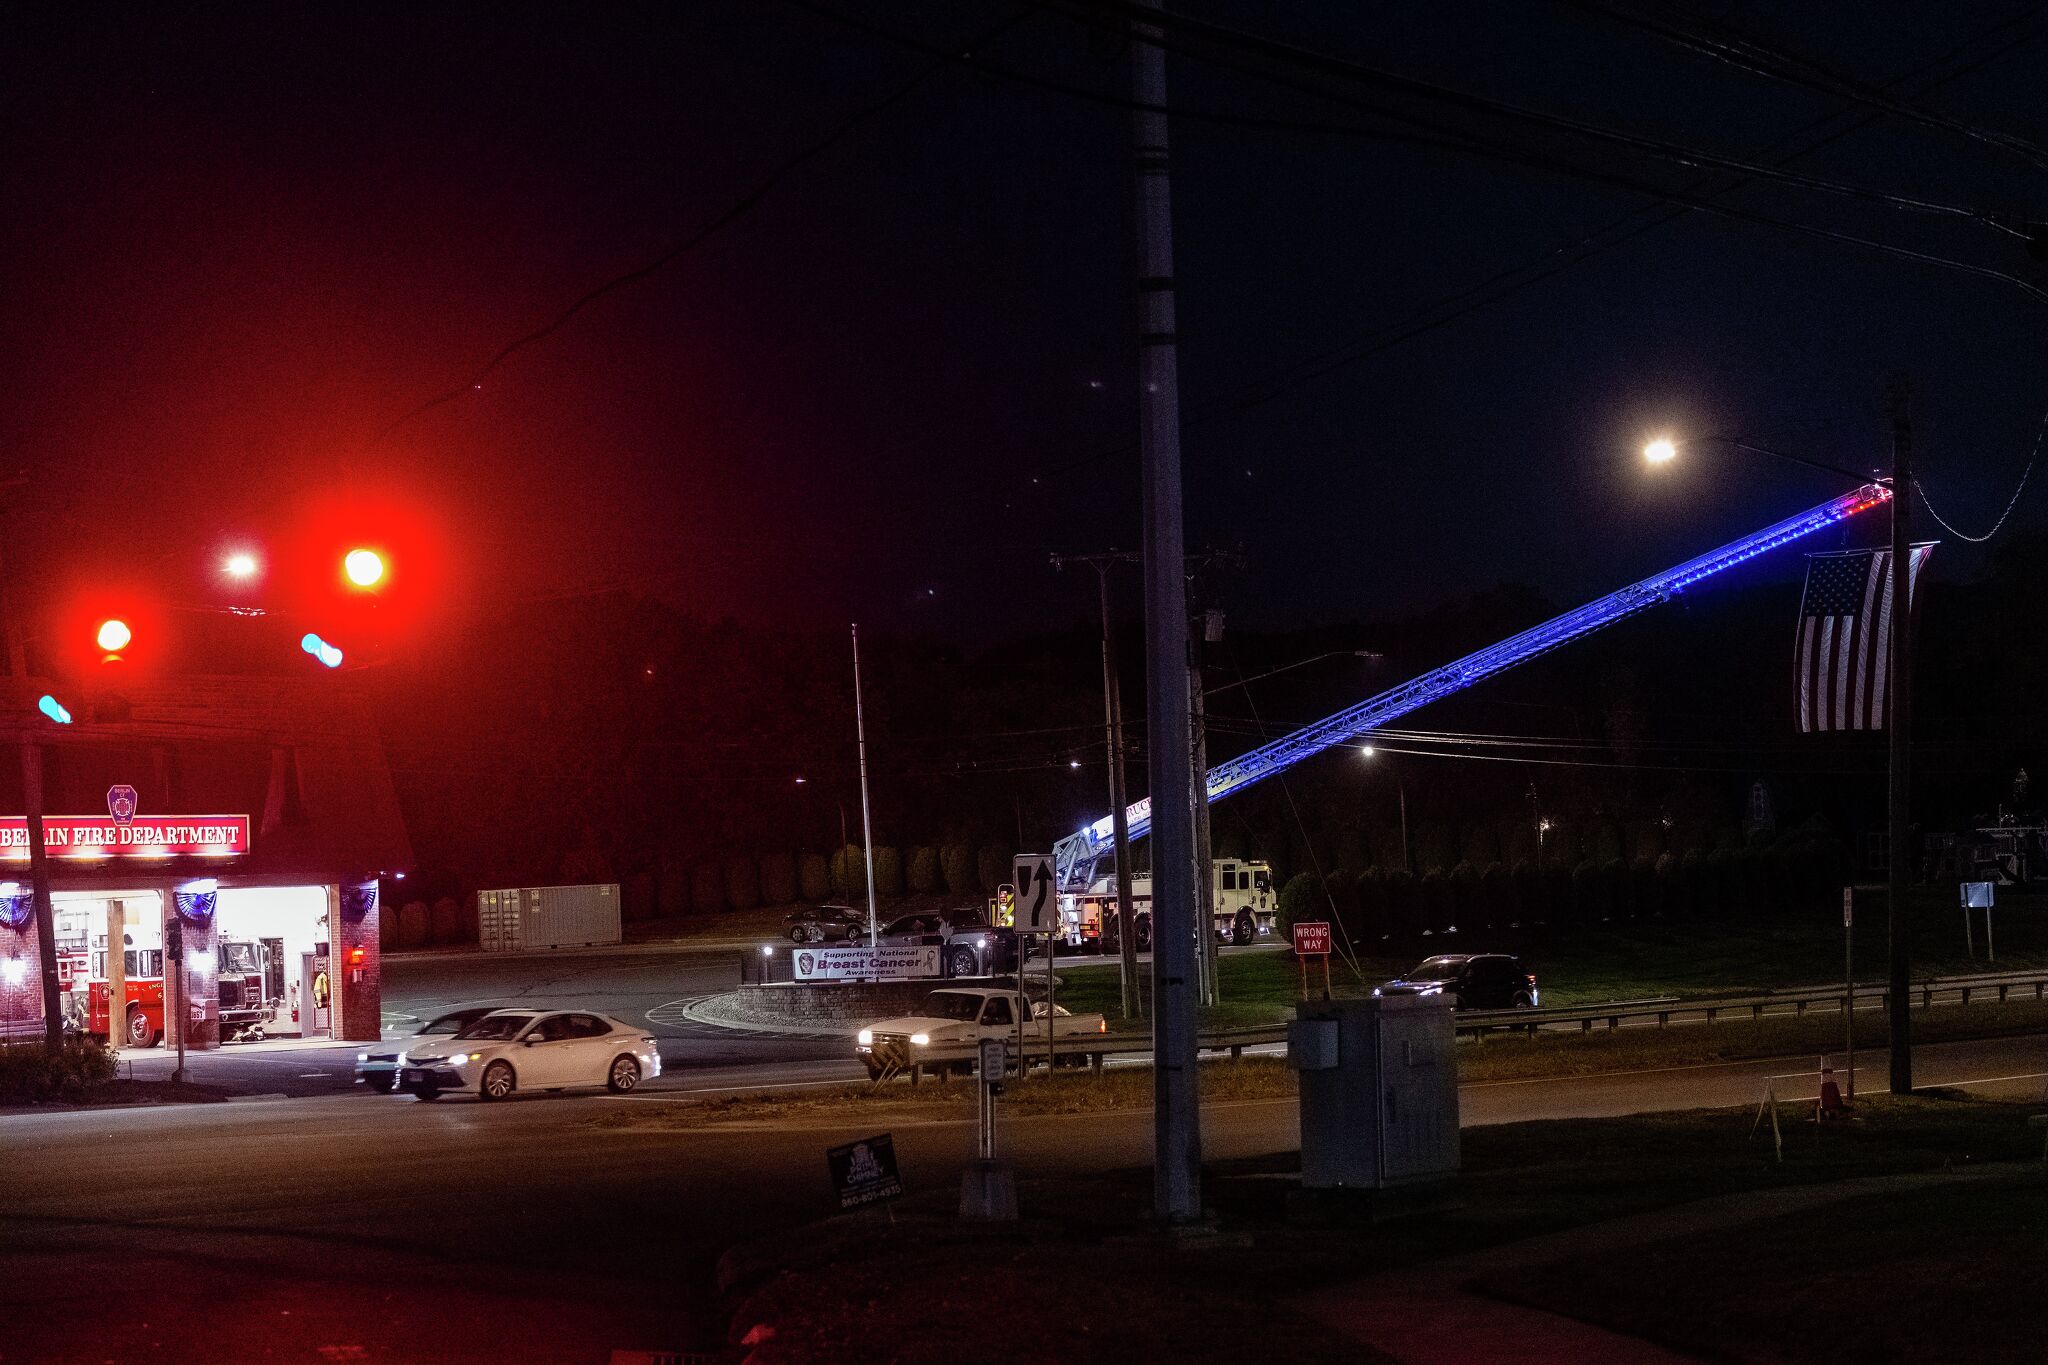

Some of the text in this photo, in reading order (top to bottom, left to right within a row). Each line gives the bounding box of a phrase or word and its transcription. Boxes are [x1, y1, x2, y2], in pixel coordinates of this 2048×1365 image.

[73, 828, 116, 846] FIRE
[120, 826, 239, 845] DEPARTMENT
[1296, 927, 1328, 938] WRONG
[1303, 939, 1322, 950] WAY
[817, 959, 922, 969] Breast Cancer
